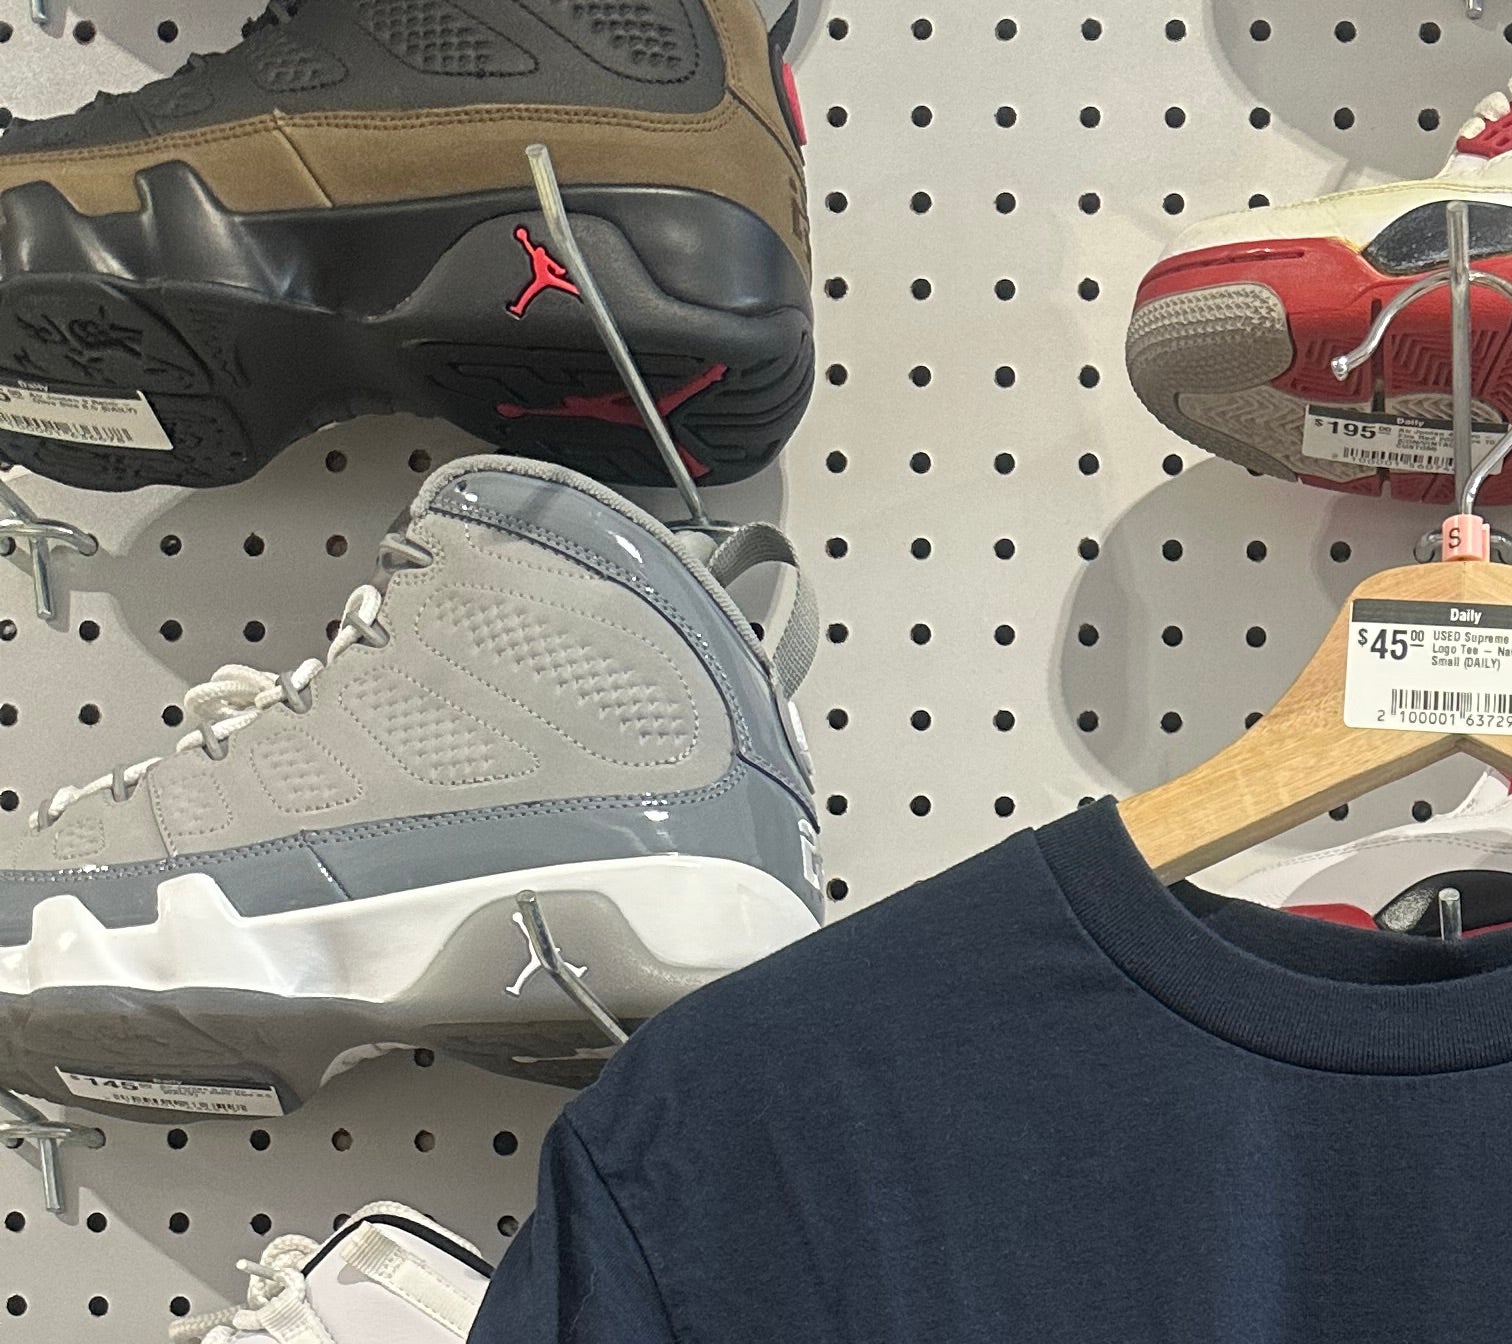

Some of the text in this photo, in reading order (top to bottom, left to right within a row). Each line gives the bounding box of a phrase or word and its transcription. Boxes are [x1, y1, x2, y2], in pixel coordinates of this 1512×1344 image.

[1396, 416, 1425, 428] Daily
[1448, 527, 1462, 549] S
[1449, 607, 1482, 625] Daily
[1433, 630, 1461, 643] USED
[1464, 631, 1510, 646] Supreme
[1432, 643, 1457, 657] Logo
[1461, 645, 1479, 656] Tee
[1431, 655, 1501, 672] Small (DAILY)
[1377, 709, 1386, 723] 2
[1400, 710, 1456, 726] 100001
